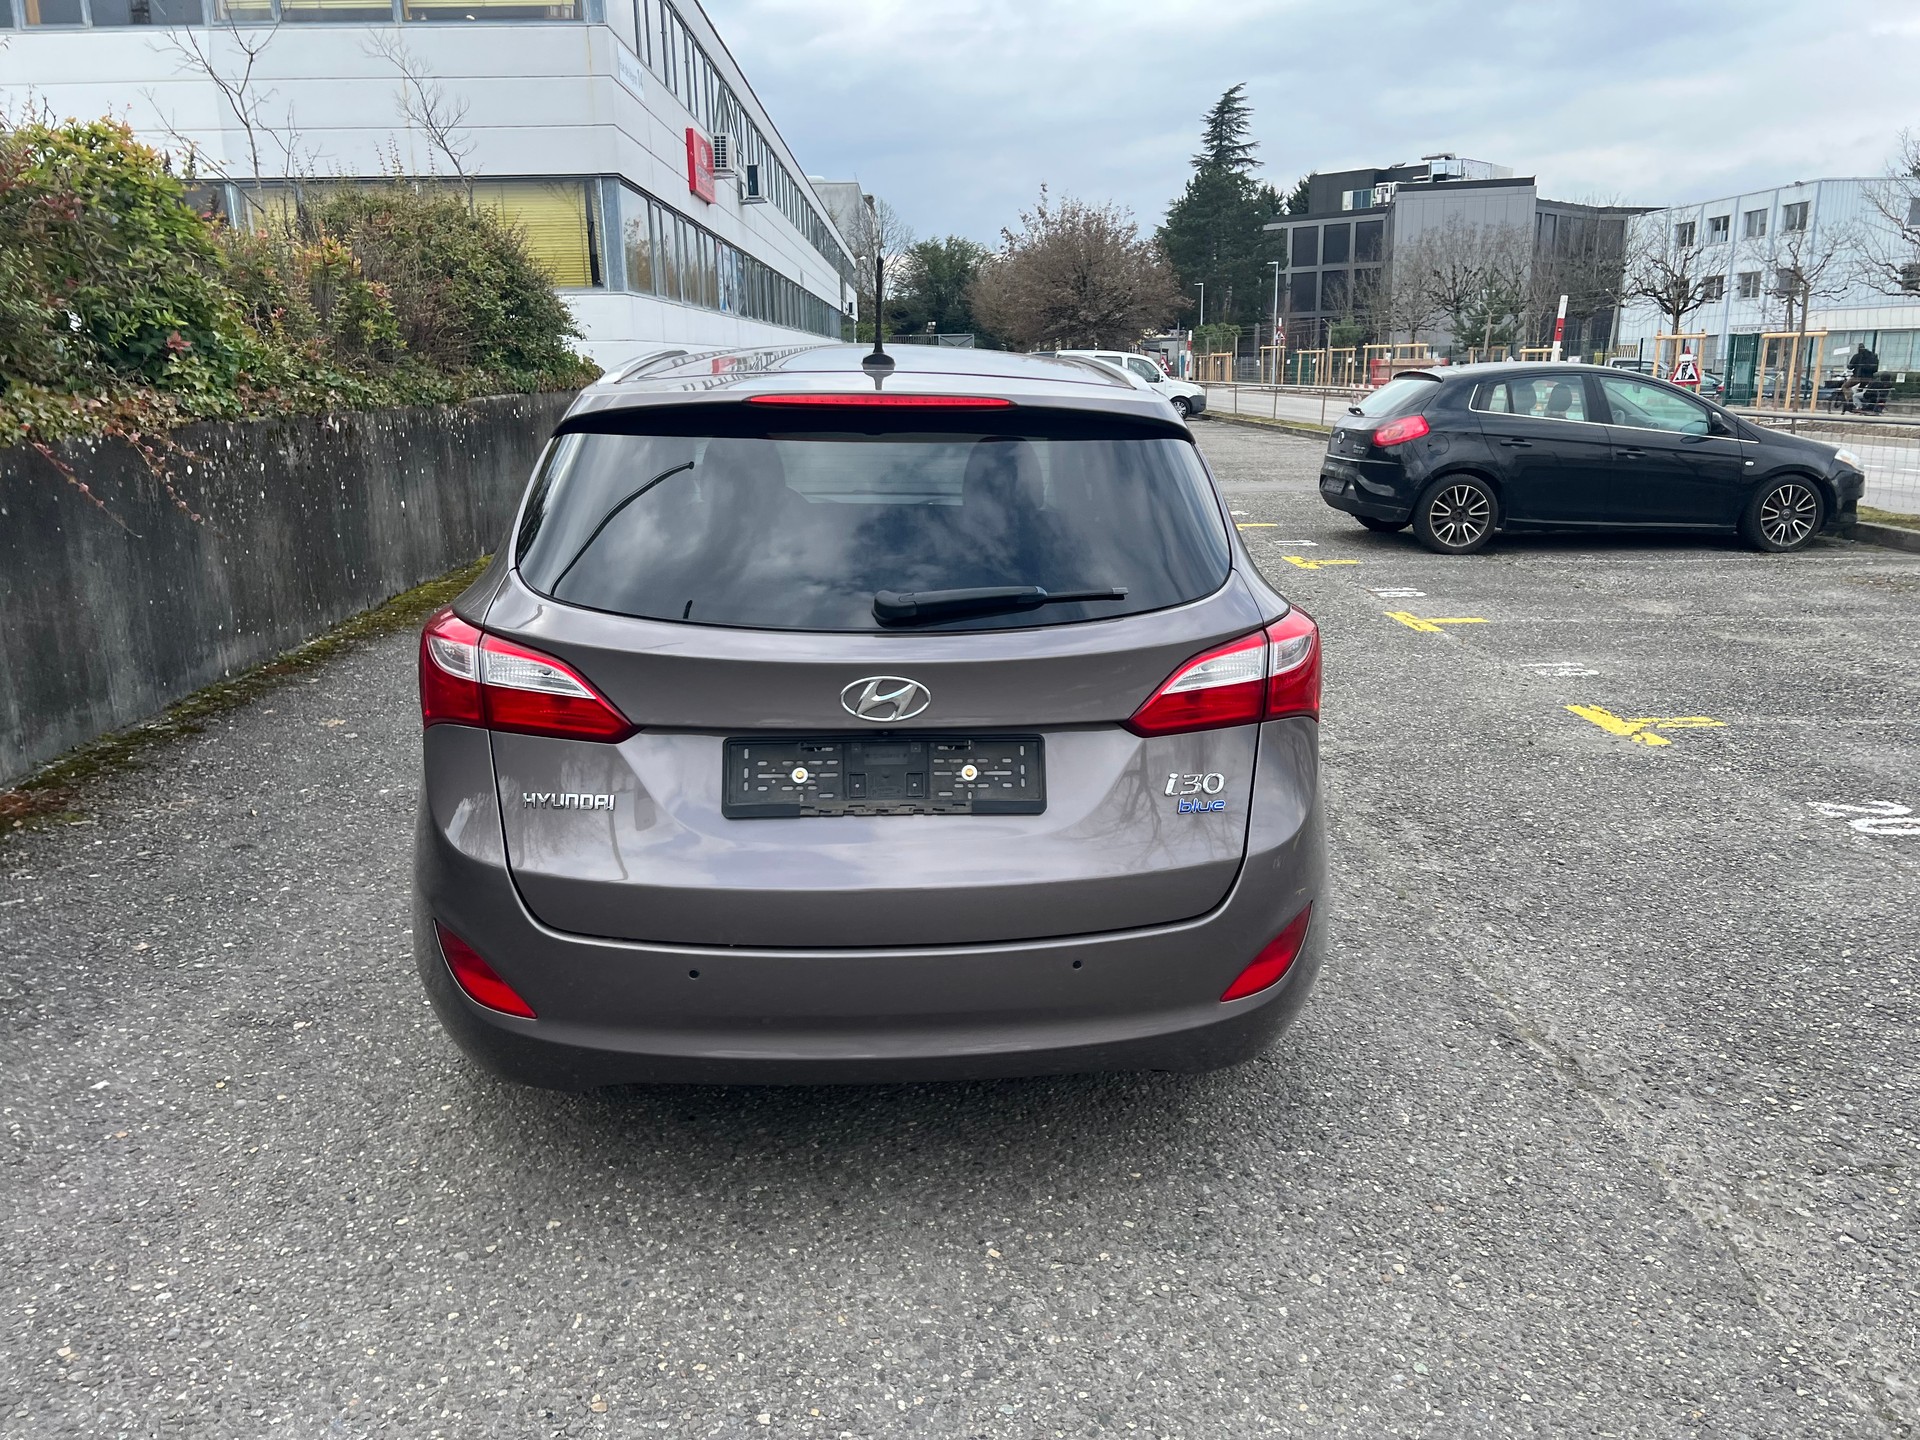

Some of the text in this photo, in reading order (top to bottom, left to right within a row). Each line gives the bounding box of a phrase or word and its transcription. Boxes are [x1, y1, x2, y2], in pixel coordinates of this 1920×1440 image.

[1164, 772, 1225, 797] i30
[522, 792, 616, 811] HYUNDAI
[1177, 797, 1226, 815] blue
